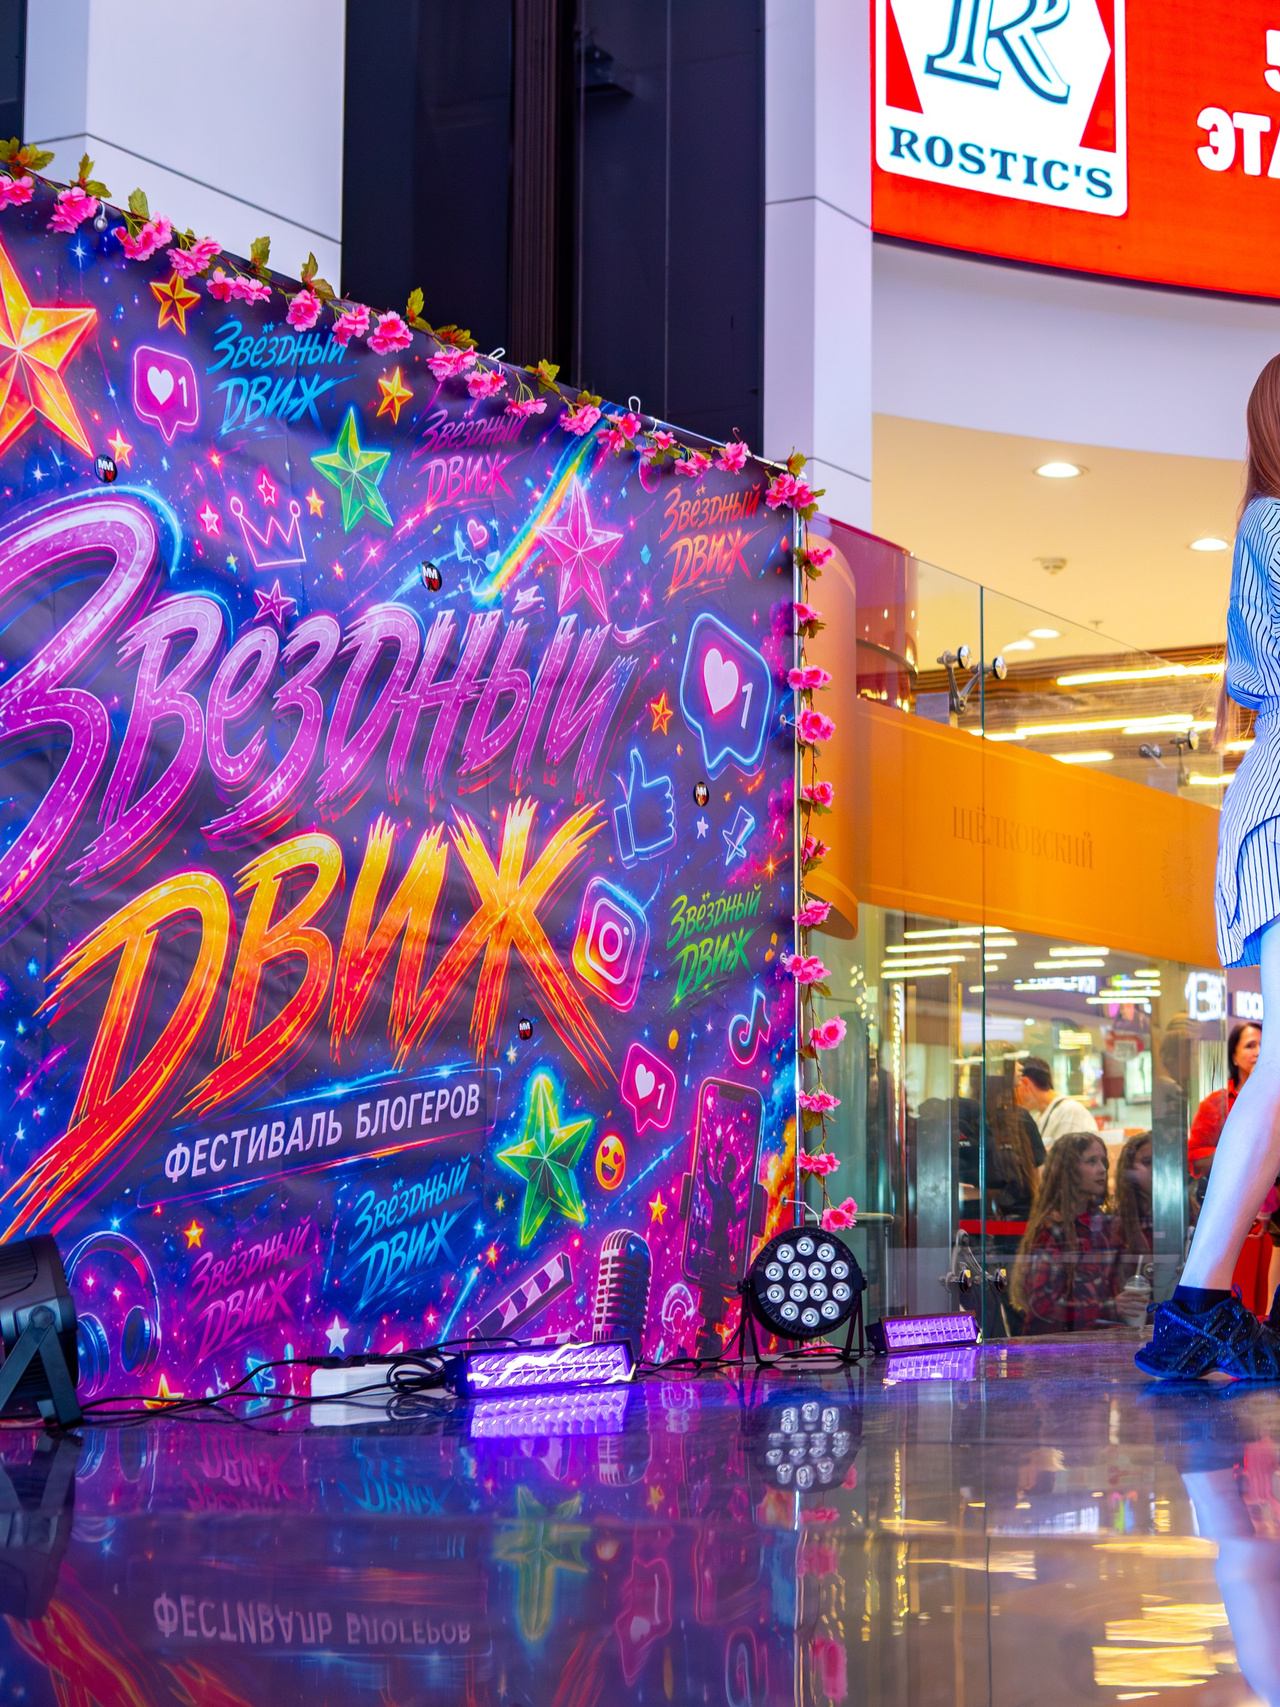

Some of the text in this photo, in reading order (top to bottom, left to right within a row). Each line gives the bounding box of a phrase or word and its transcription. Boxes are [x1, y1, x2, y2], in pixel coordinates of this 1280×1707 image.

[889, 125, 1114, 199] ROSTIC'S
[213, 372, 354, 437] ДВИЖ
[416, 451, 523, 511] ДВИЖ
[663, 527, 762, 600] ДВИЖ
[953, 805, 1093, 870] ЩЁЛКОВСКИЙ
[668, 926, 762, 1008] ДВИЖ
[0, 795, 618, 1244] ДВИЖ
[164, 1083, 480, 1184] ФЕСТИВАЛЬ БЛОГЕРОВ
[341, 1206, 472, 1308] ДВИЖ
[193, 1262, 314, 1360] ДВИЖ
